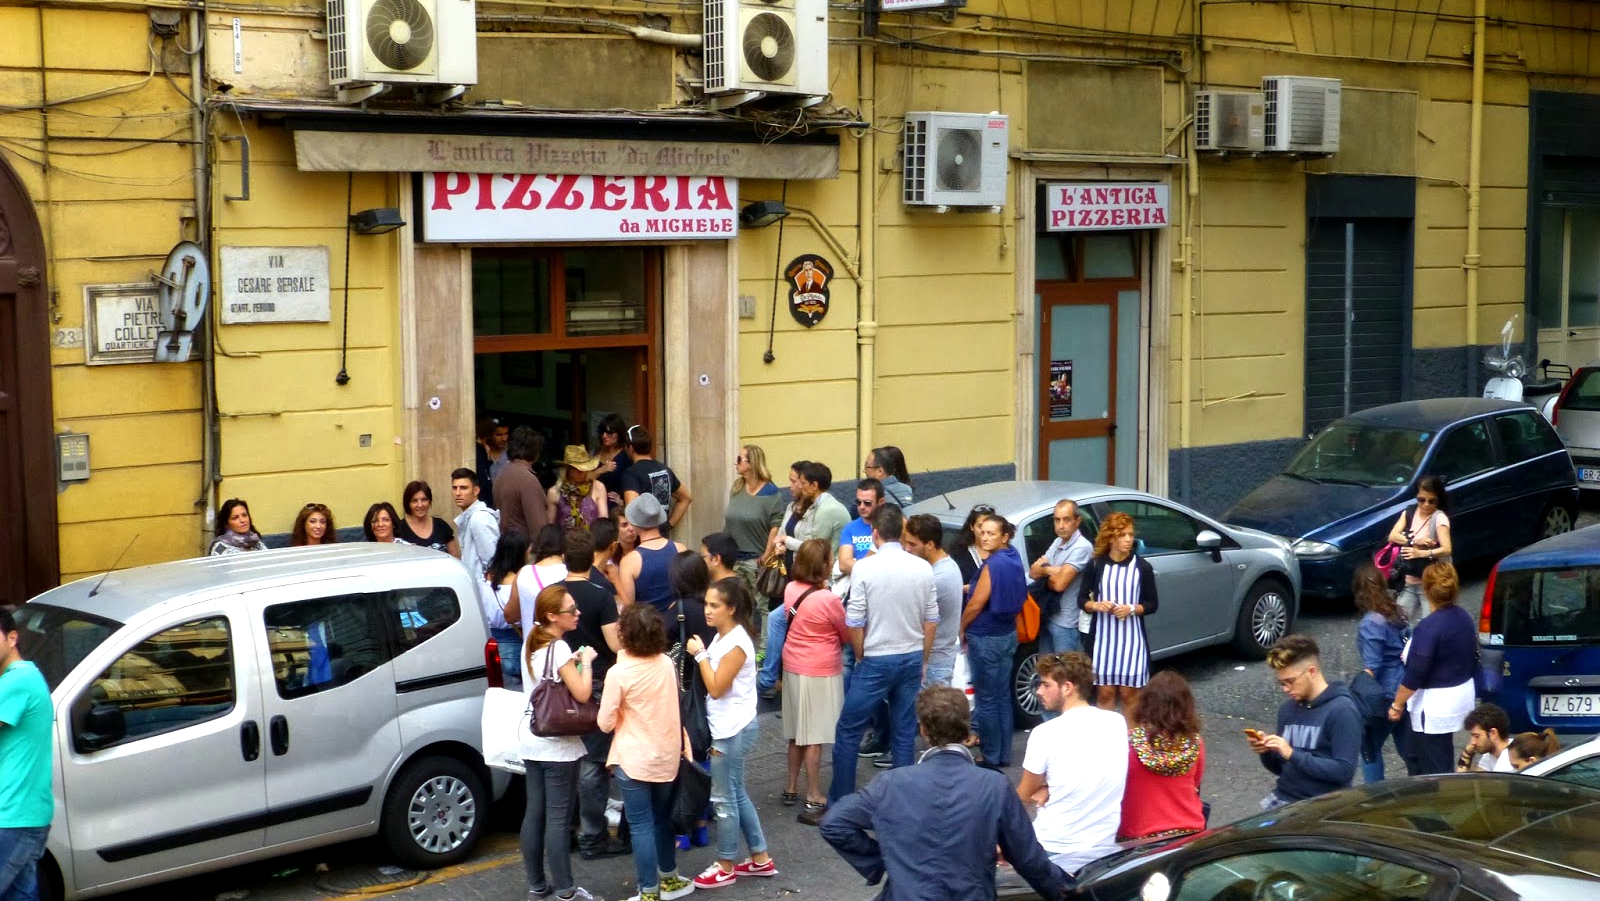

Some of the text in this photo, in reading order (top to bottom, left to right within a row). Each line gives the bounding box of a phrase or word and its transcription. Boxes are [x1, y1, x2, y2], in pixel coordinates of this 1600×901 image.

[427, 139, 740, 169] L'antica Pizzeria "da Michele"
[431, 172, 734, 213] PIZZERIA
[1060, 187, 1158, 206] L'ANTICA
[1051, 207, 1167, 227] PIZZERIA
[619, 218, 733, 233] da MICHELE
[268, 255, 284, 268] VIA
[237, 277, 315, 293] CESARE SERSALE
[134, 298, 154, 312] VIA
[57, 330, 76, 344] 23
[115, 326, 167, 341] COLLET
[105, 340, 150, 351] QUARTIERE
[1584, 470, 1594, 480] BR
[1543, 696, 1559, 712] AZ
[1567, 696, 1592, 712] 679
